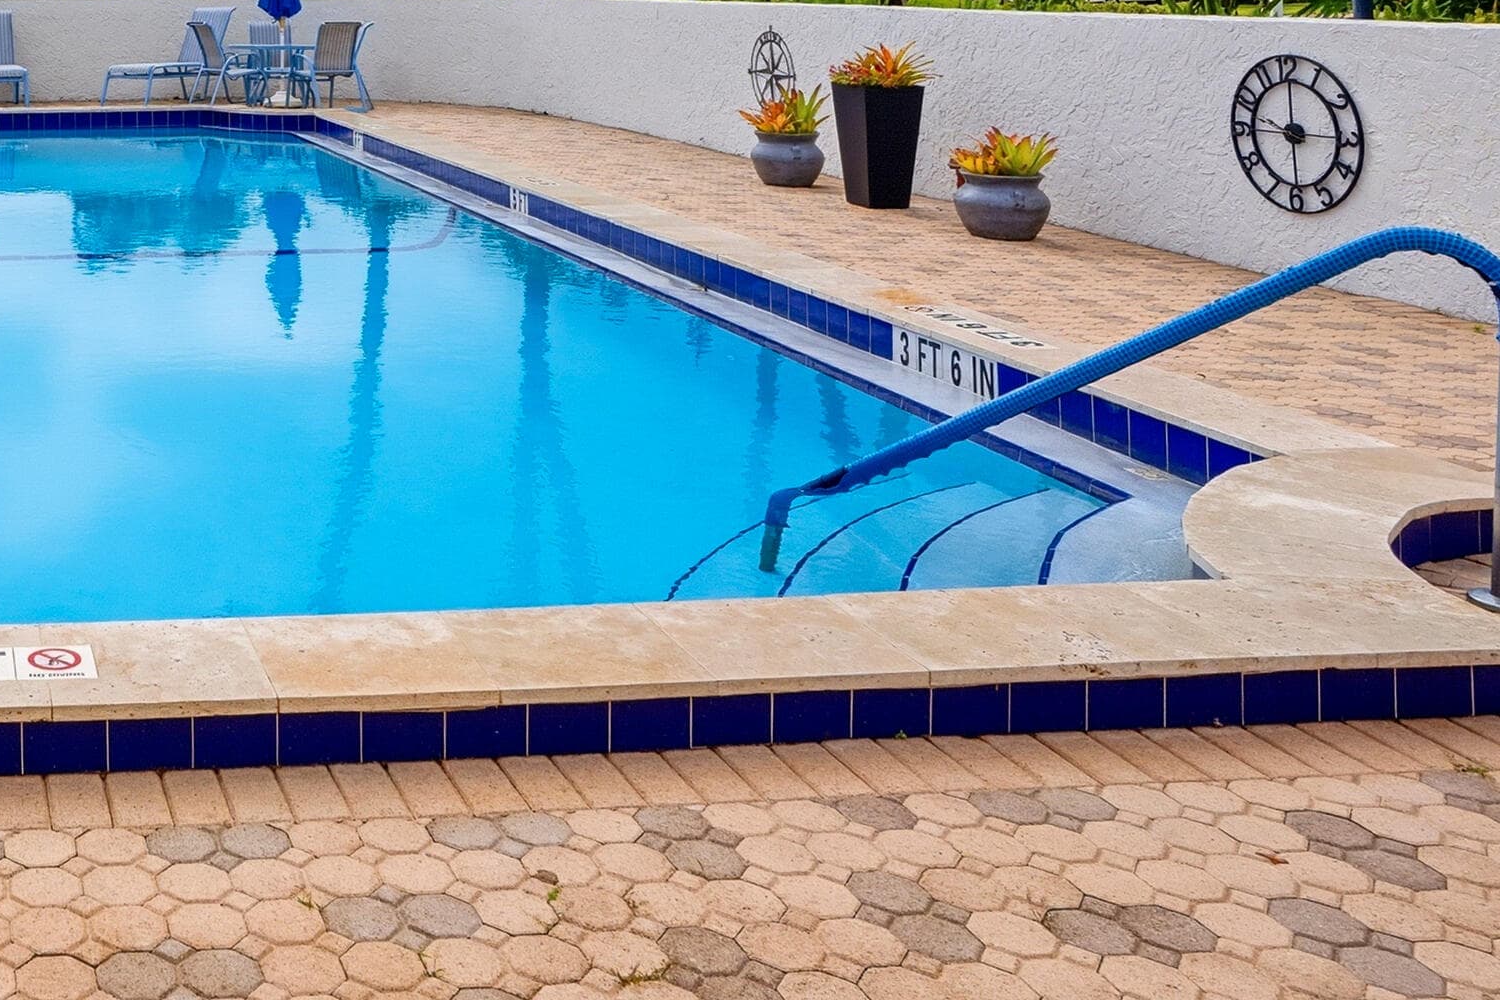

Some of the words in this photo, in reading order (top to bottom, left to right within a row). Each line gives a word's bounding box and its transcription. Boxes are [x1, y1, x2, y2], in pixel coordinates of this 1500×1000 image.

[1275, 56, 1298, 82] 12
[1311, 67, 1322, 89] 1
[1236, 85, 1257, 113] 10
[1327, 93, 1349, 110] 2
[1233, 121, 1251, 137] 9
[1338, 131, 1359, 148] 3
[1241, 151, 1260, 172] 8
[1335, 161, 1355, 180] 4
[1289, 185, 1304, 211] 6
[1313, 185, 1334, 207] 5
[900, 331, 909, 366] 3
[917, 337, 940, 378] FT
[951, 350, 961, 387] 6
[972, 356, 994, 401] IN
